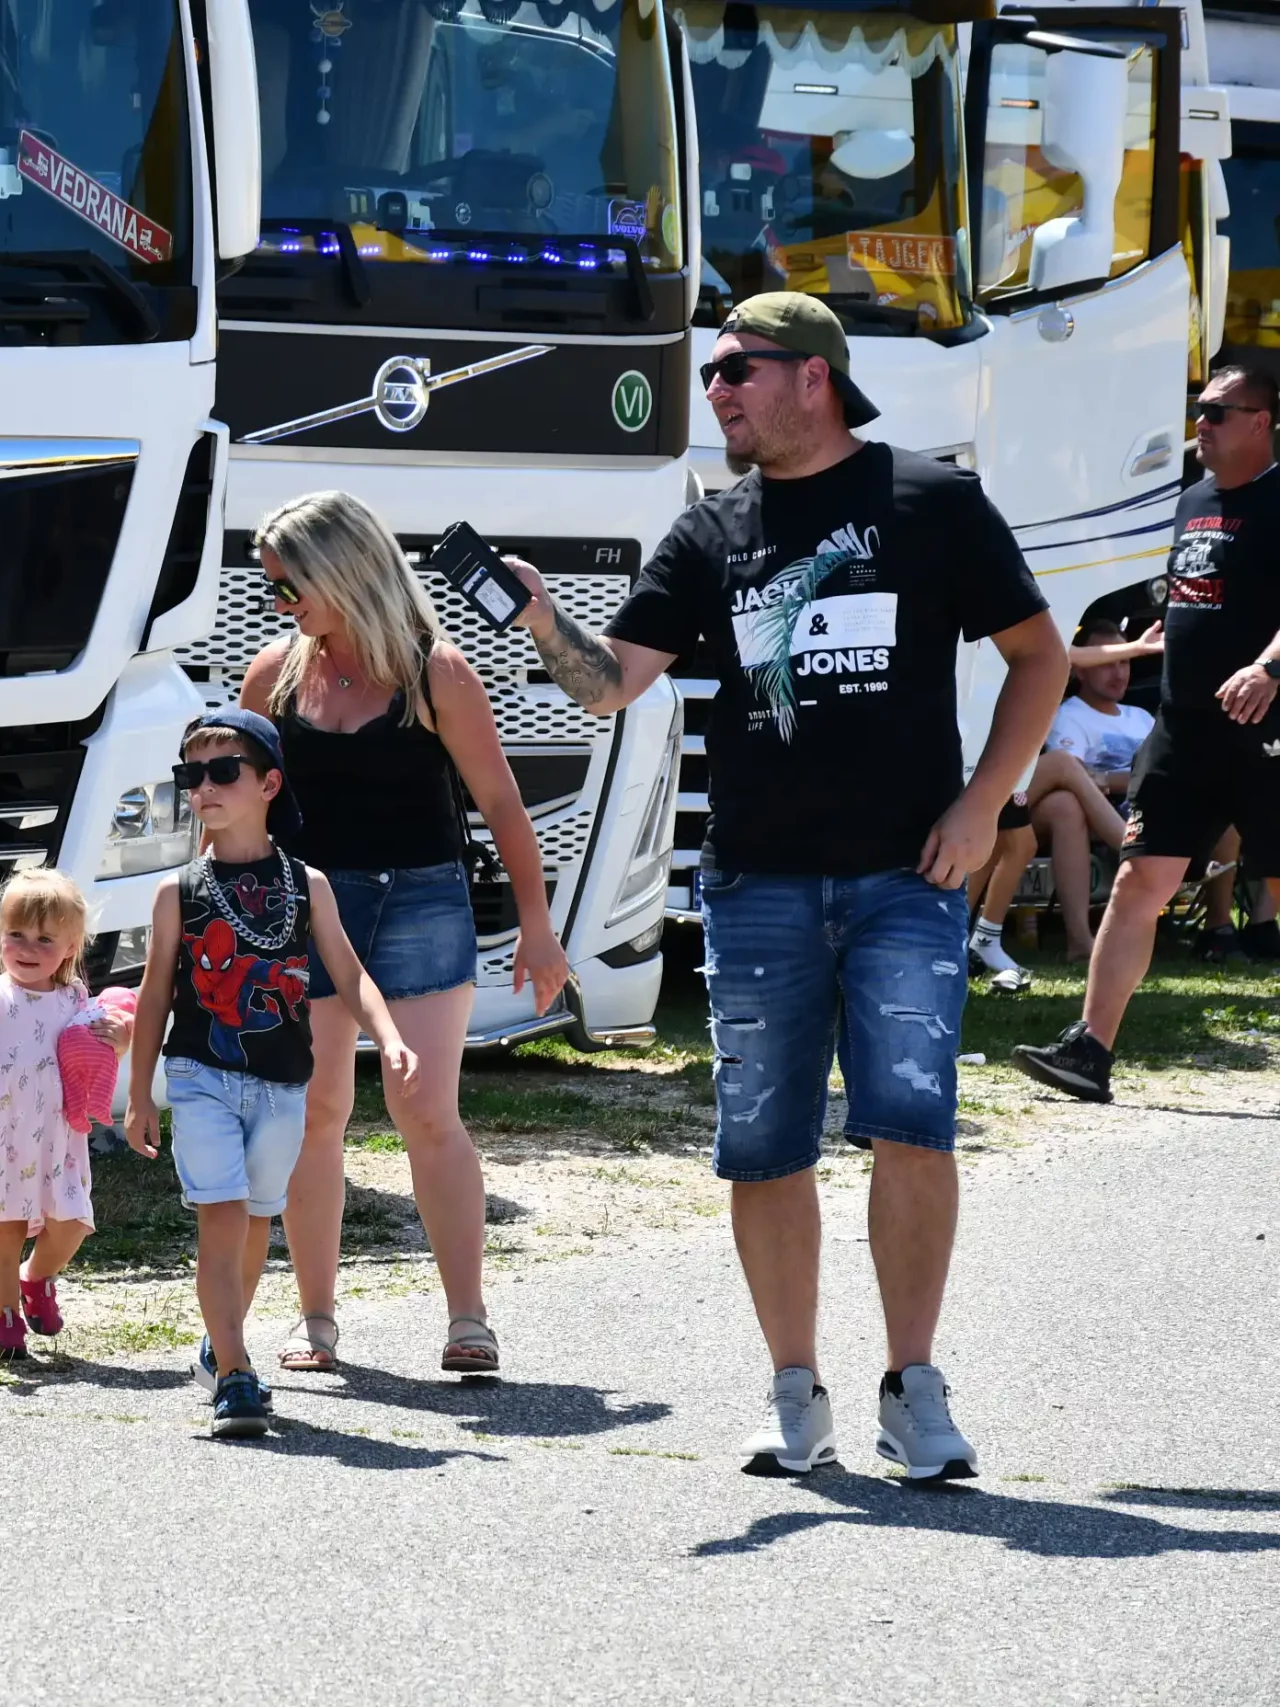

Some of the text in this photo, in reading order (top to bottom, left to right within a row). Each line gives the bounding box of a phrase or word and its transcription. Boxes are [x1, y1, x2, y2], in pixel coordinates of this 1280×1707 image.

[49, 153, 138, 250] VEDRANA
[620, 385, 644, 418] VI
[595, 547, 621, 564] FH
[727, 545, 777, 564] GOLD COAST
[731, 580, 804, 613] JACK
[809, 613, 829, 637] &
[796, 648, 889, 676] JONES
[839, 681, 888, 694] EST. 1990
[748, 721, 763, 731] LIFE
